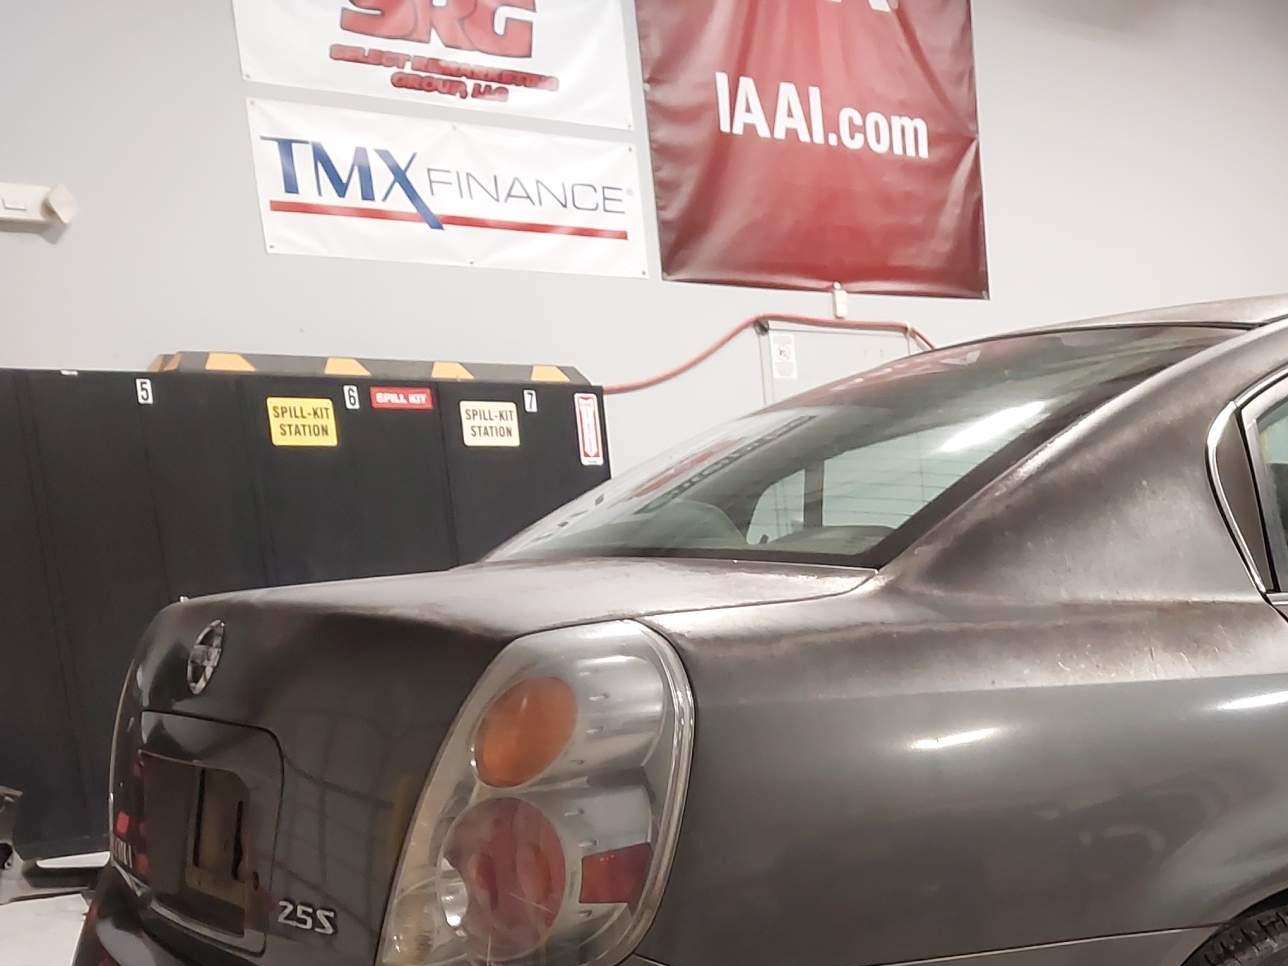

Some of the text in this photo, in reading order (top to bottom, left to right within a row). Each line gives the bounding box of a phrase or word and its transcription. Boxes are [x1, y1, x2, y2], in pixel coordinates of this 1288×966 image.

[715, 71, 929, 159] IAAI.com
[260, 136, 626, 230] TMX FINANCE
[139, 381, 150, 402] 5
[347, 386, 357, 407] 6
[527, 391, 535, 409] 7
[273, 405, 331, 420] SPILL-KIT
[465, 408, 514, 422] SPILL-KIT
[280, 423, 330, 437] STATION
[470, 425, 513, 438] STATION
